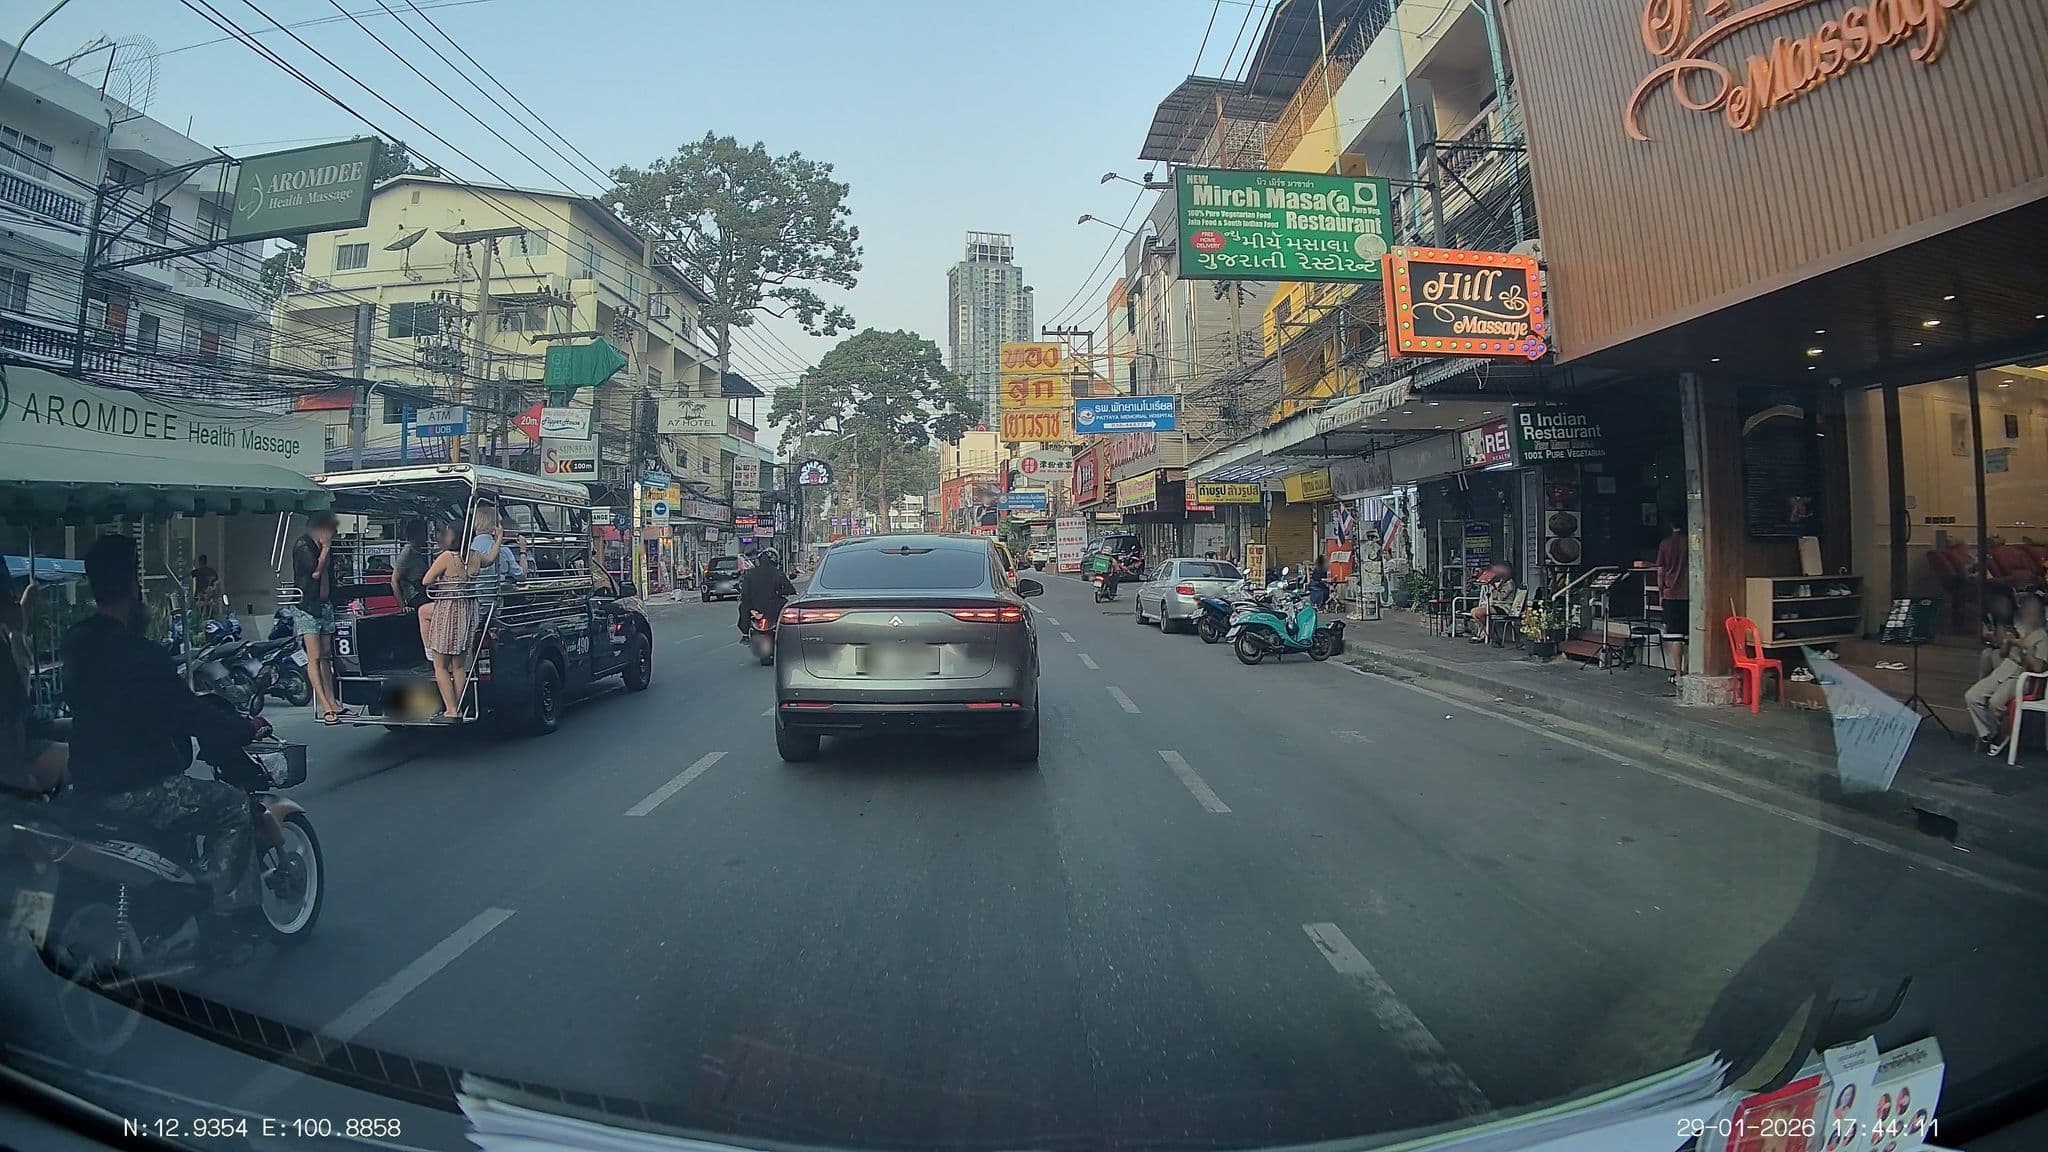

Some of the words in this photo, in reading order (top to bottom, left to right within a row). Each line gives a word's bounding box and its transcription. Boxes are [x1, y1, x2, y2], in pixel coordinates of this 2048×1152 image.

[267, 161, 363, 194] AROMDEE
[1186, 174, 1209, 185] NEW
[269, 192, 302, 210] Health
[307, 189, 353, 205] Massage
[1193, 184, 1261, 208] Mirch
[1265, 187, 1350, 217] Masala
[1187, 209, 1204, 217] 100%
[1221, 210, 1255, 219] Vegetarian
[1256, 211, 1272, 219] Food
[1352, 205, 1367, 214] Pure
[1187, 218, 1201, 226] Jain
[1223, 219, 1242, 227] South
[1243, 220, 1263, 228] Indian
[1264, 221, 1279, 229] Food
[1286, 211, 1382, 234] Restaurant
[1286, 237, 1349, 253] મસાલા
[1197, 251, 1287, 270] ગુજરાતી
[1422, 269, 1503, 302] Hill
[1453, 315, 1529, 341] Massage
[1004, 347, 1059, 369] ทอง
[428, 410, 451, 421] ATM
[667, 419, 680, 427] A7
[682, 419, 716, 427] HOTEL
[1537, 411, 1587, 427] Indian
[22, 391, 178, 441] AROMDEE
[188, 421, 236, 449] Health
[241, 429, 300, 460] Massage
[435, 425, 452, 434] UOB
[1004, 411, 1060, 438] เยาวราช
[1523, 424, 1602, 441] Restaurant
[560, 444, 595, 455] SUNBEAM
[1524, 451, 1544, 461] 100%
[1546, 449, 1565, 460] PURE
[573, 462, 593, 470] 100m
[1199, 484, 1226, 498] ถ่ายรูป
[339, 638, 351, 655] 8
[576, 635, 590, 655] 490
